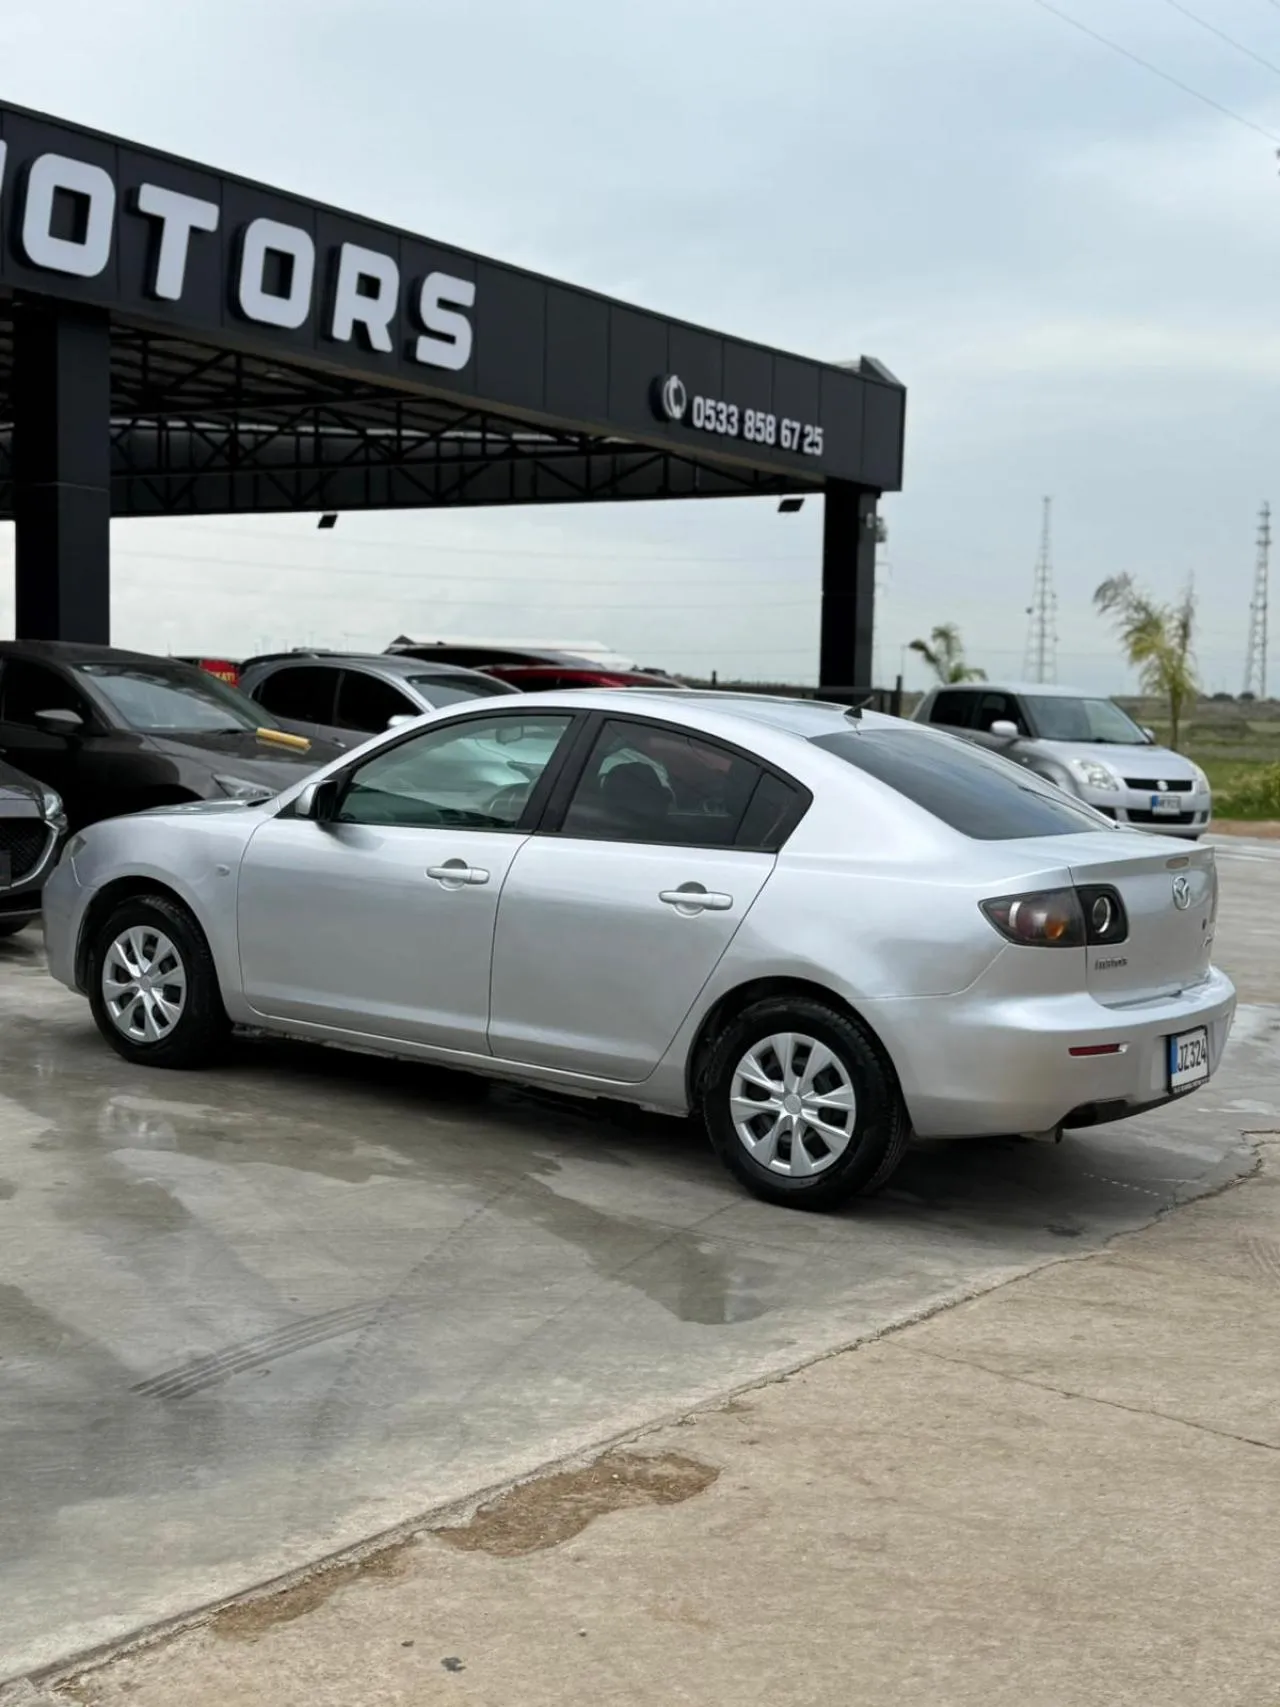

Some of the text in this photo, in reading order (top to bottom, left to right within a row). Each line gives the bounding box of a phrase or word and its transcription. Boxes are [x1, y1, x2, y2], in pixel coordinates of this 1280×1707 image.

[0, 139, 476, 371] OTORS
[692, 396, 823, 455] 0533 858 67 25
